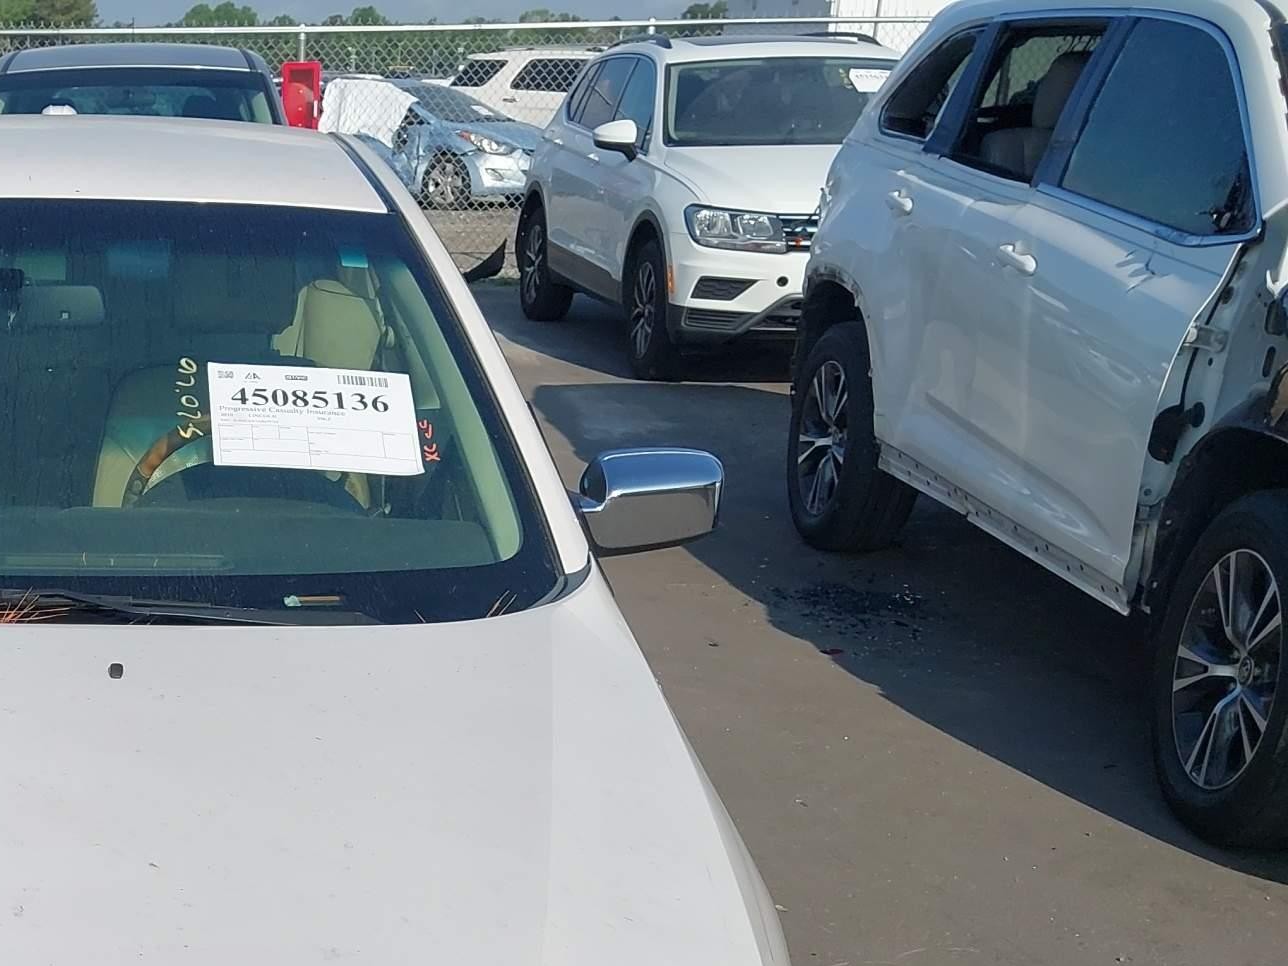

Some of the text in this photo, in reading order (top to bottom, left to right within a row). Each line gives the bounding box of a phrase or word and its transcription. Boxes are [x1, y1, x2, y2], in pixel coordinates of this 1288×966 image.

[231, 387, 390, 413] 45085136
[219, 405, 346, 417] Progressive Casualty Insurance
